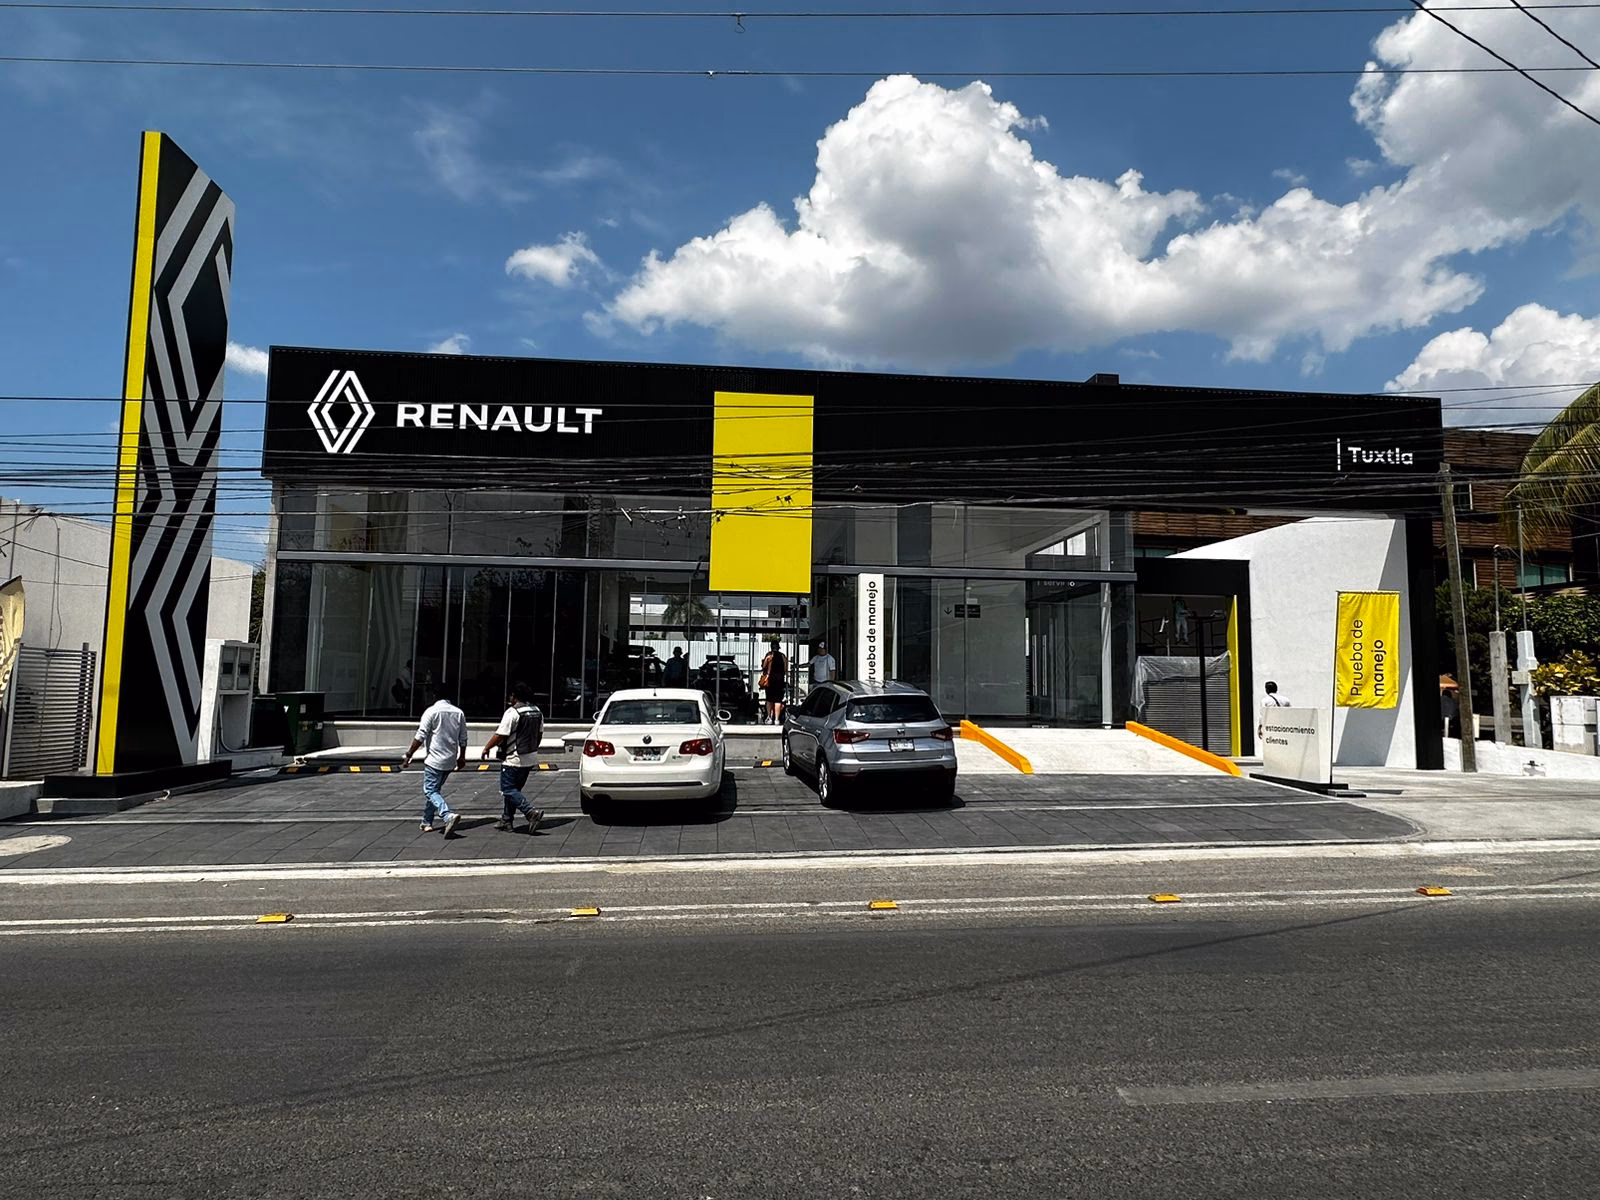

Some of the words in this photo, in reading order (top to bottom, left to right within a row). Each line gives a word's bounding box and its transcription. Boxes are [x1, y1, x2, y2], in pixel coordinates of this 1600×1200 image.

[396, 403, 603, 434] RENAULT
[1347, 446, 1414, 465] Tuxtla
[866, 581, 878, 626] manejo
[866, 627, 876, 643] de
[1350, 619, 1363, 639] de
[866, 645, 876, 681] rueba
[1349, 642, 1363, 696] Prueba
[1371, 639, 1387, 697] manejo
[1265, 725, 1315, 735] estacionamiento
[1265, 736, 1288, 746] clientes
